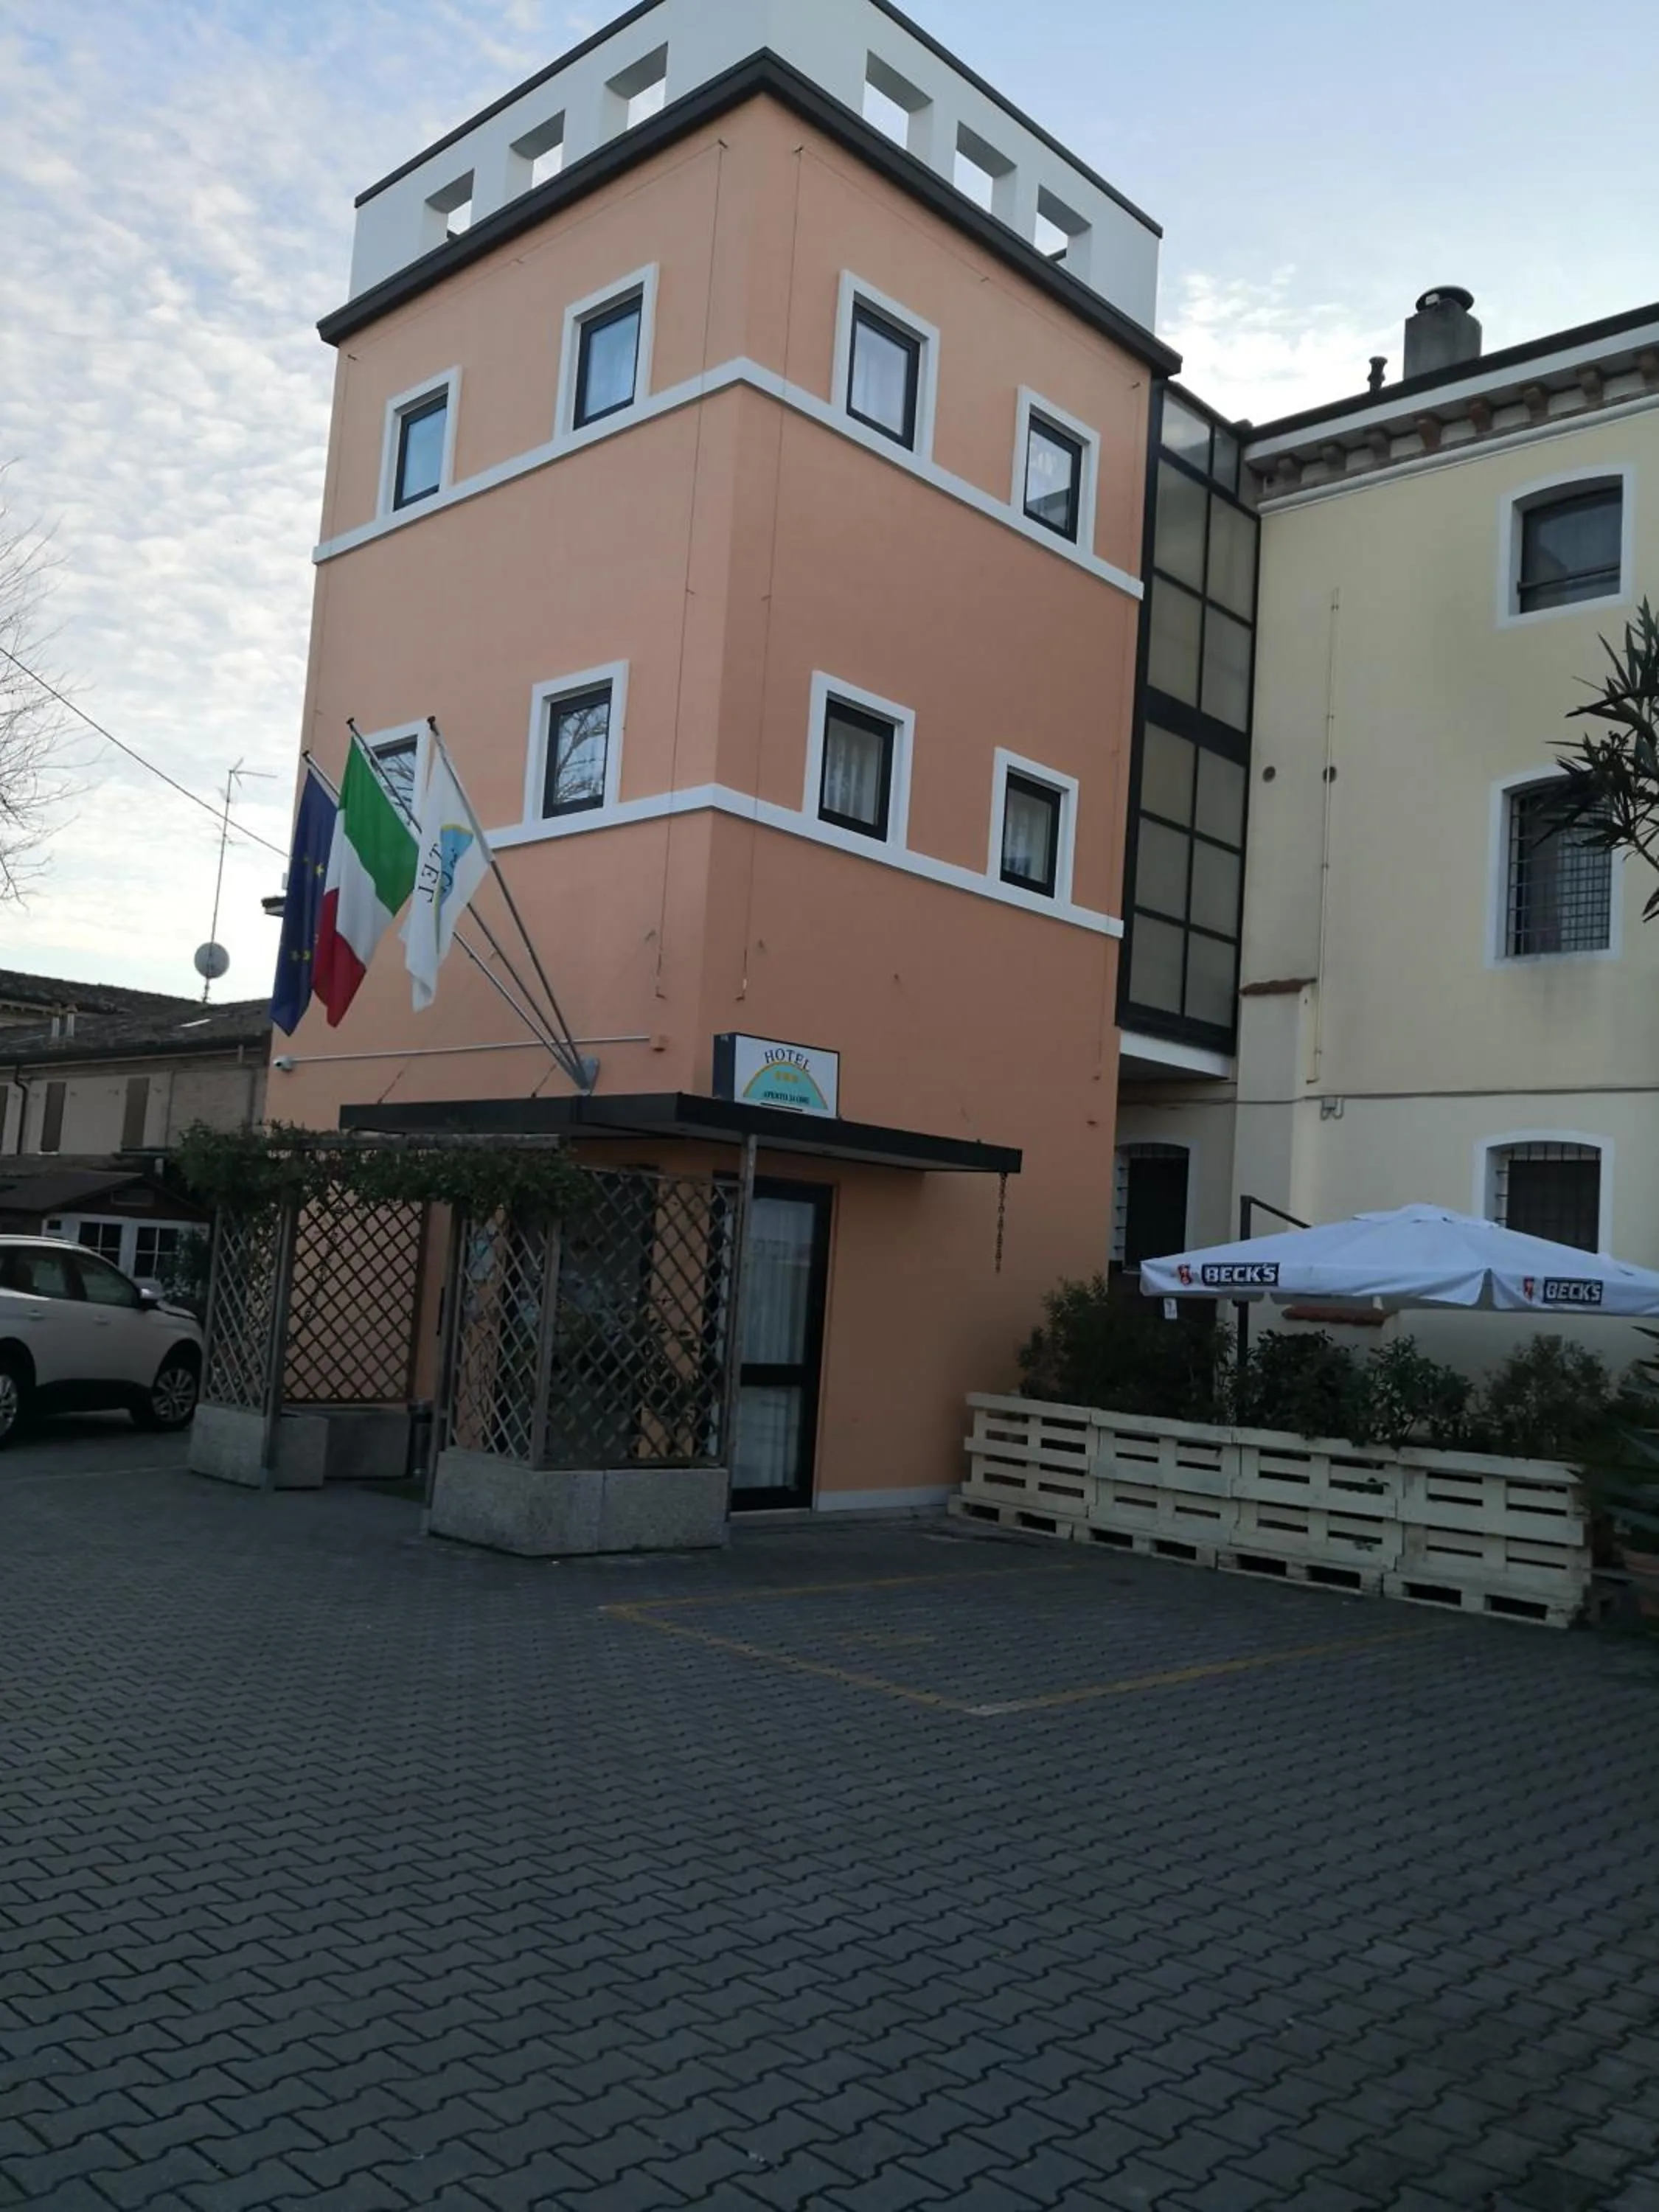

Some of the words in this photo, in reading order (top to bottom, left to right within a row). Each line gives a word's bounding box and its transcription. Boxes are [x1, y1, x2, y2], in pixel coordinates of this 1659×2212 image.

[764, 1048, 810, 1072] HOTEL
[1204, 1263, 1277, 1283] BECK'S
[1545, 1281, 1601, 1301] BECK'S
